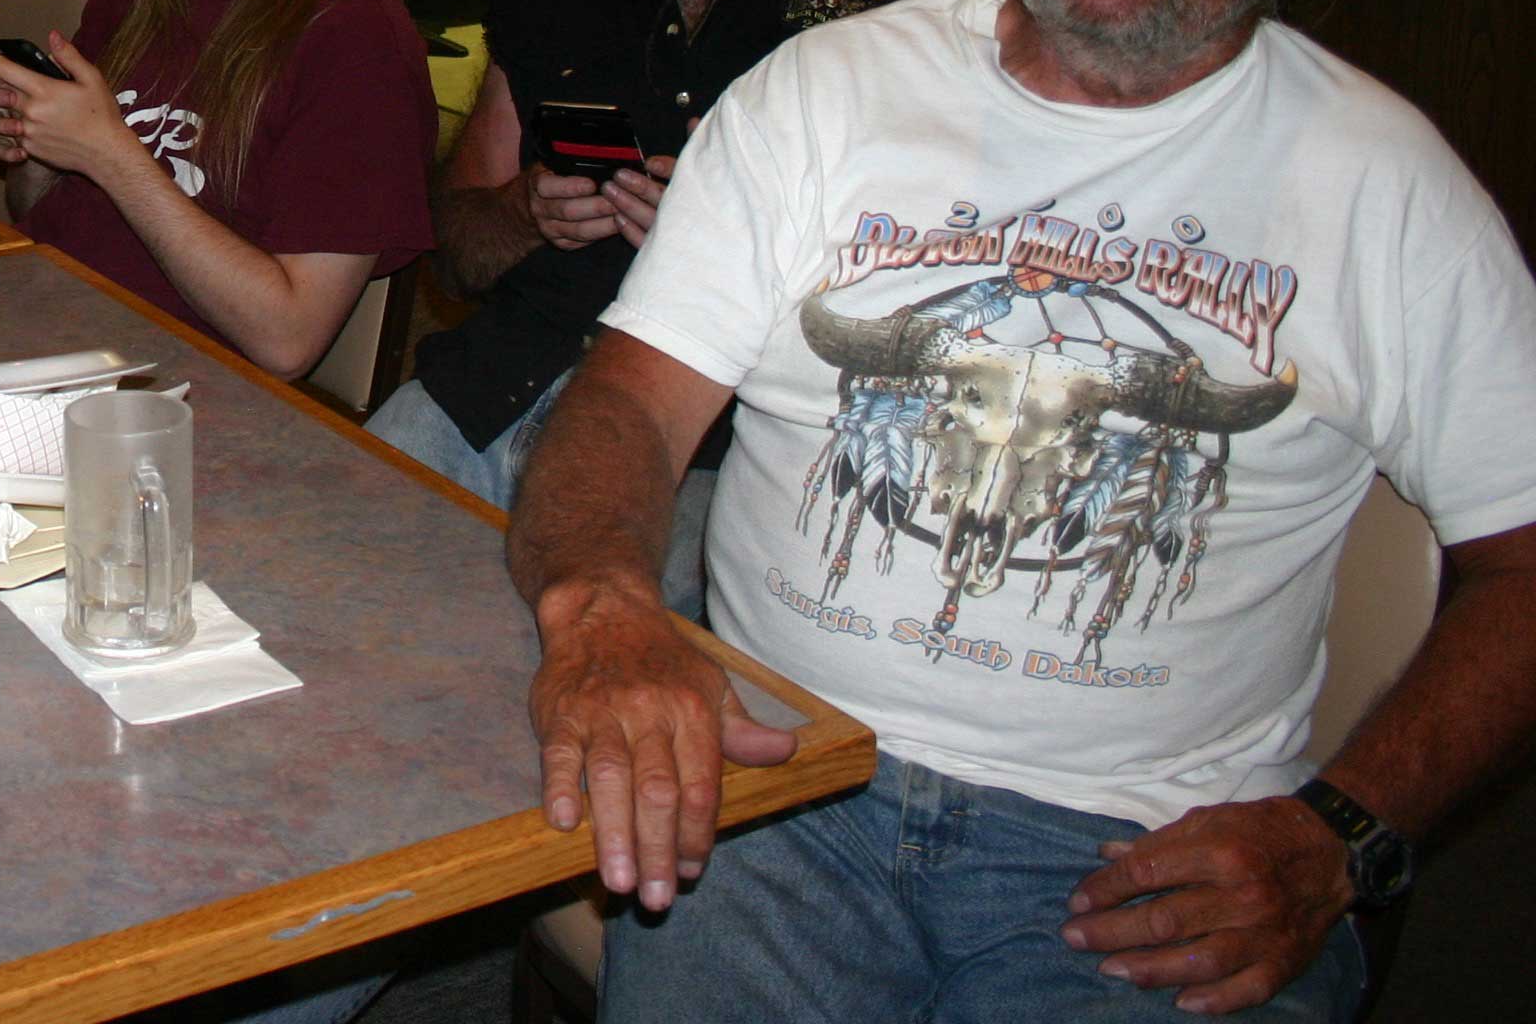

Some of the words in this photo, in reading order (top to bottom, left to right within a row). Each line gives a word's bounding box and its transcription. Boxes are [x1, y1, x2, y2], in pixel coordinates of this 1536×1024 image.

[1008, 213, 1138, 285] HILLS
[1135, 238, 1298, 377] RALLY
[888, 617, 1013, 672] South
[1022, 648, 1171, 689] Dakota
